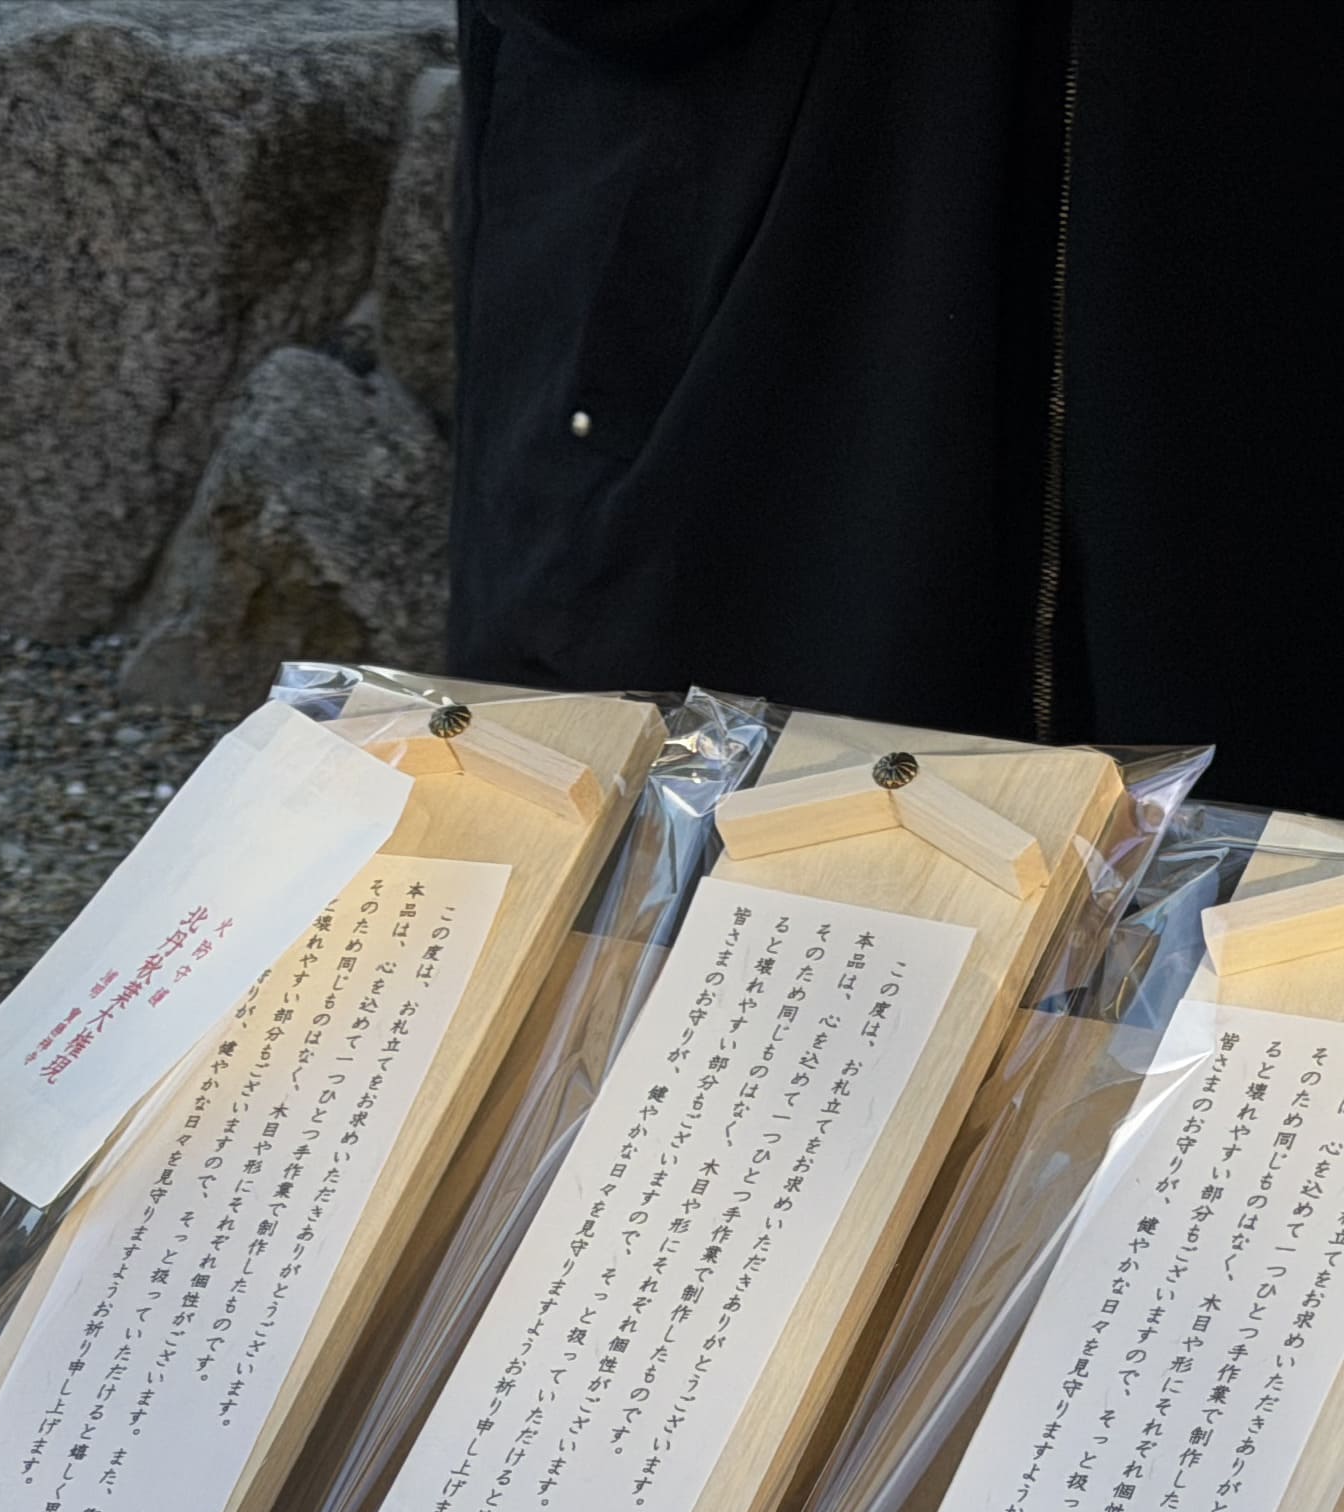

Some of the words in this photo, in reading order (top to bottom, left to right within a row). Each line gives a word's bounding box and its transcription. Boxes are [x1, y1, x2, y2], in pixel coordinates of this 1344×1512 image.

[39, 905, 209, 1085] 北丹秋葉大権現
